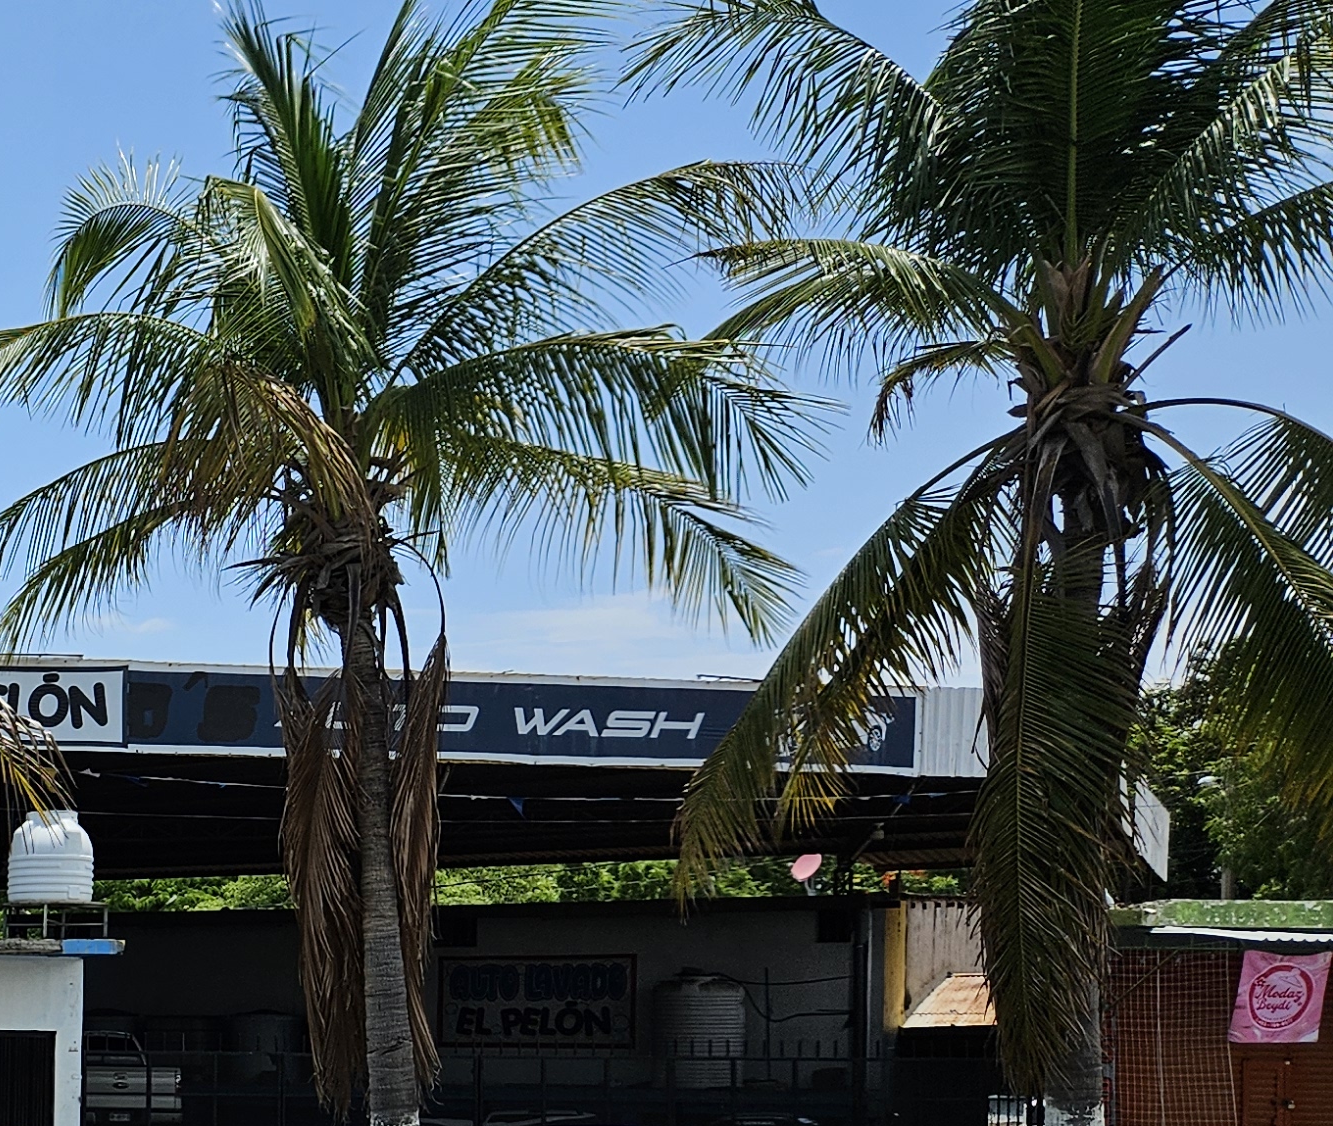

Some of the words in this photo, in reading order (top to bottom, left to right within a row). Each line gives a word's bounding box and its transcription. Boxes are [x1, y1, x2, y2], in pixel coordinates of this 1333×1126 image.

[514, 706, 705, 740] WASH
[449, 964, 520, 1001] AUTO
[524, 962, 628, 1001] LAVADO
[455, 1006, 493, 1036] EL
[500, 1000, 613, 1037] PELÓN
